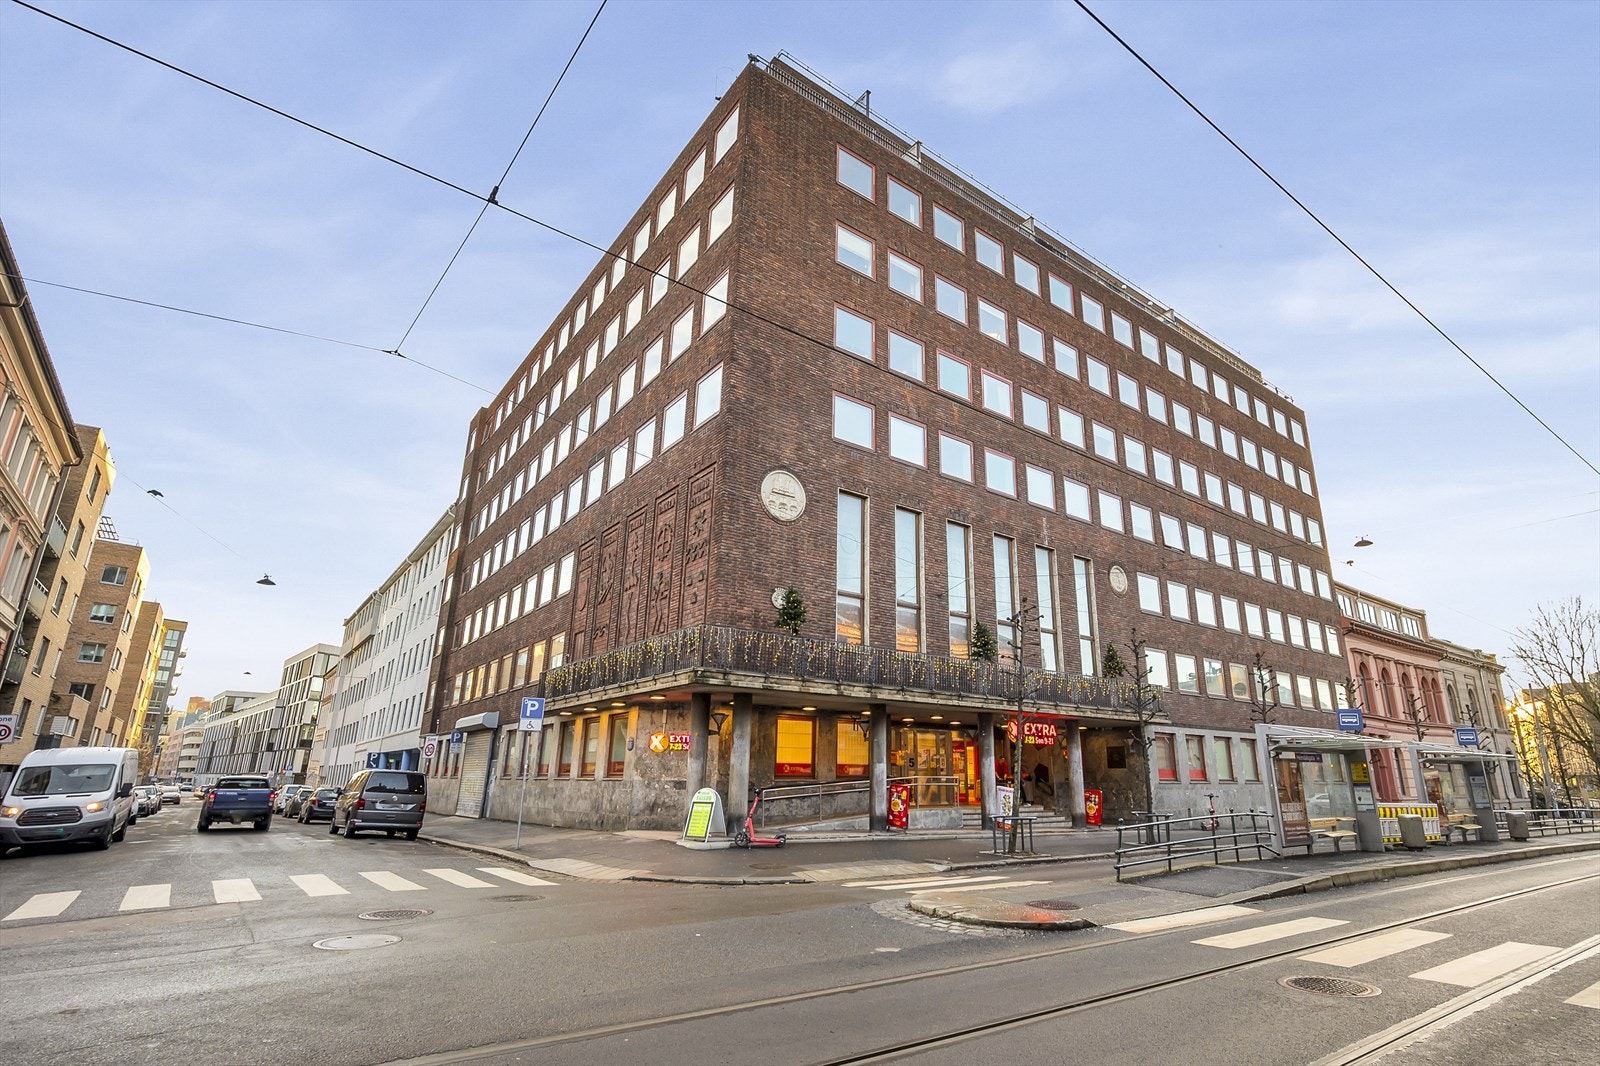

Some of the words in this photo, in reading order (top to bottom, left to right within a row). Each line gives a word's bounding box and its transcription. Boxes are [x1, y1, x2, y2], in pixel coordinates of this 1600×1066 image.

[526, 700, 539, 717] P
[1024, 723, 1057, 736] EXTRA
[453, 733, 461, 742] P
[370, 753, 378, 761] P
[909, 758, 915, 767] 5
